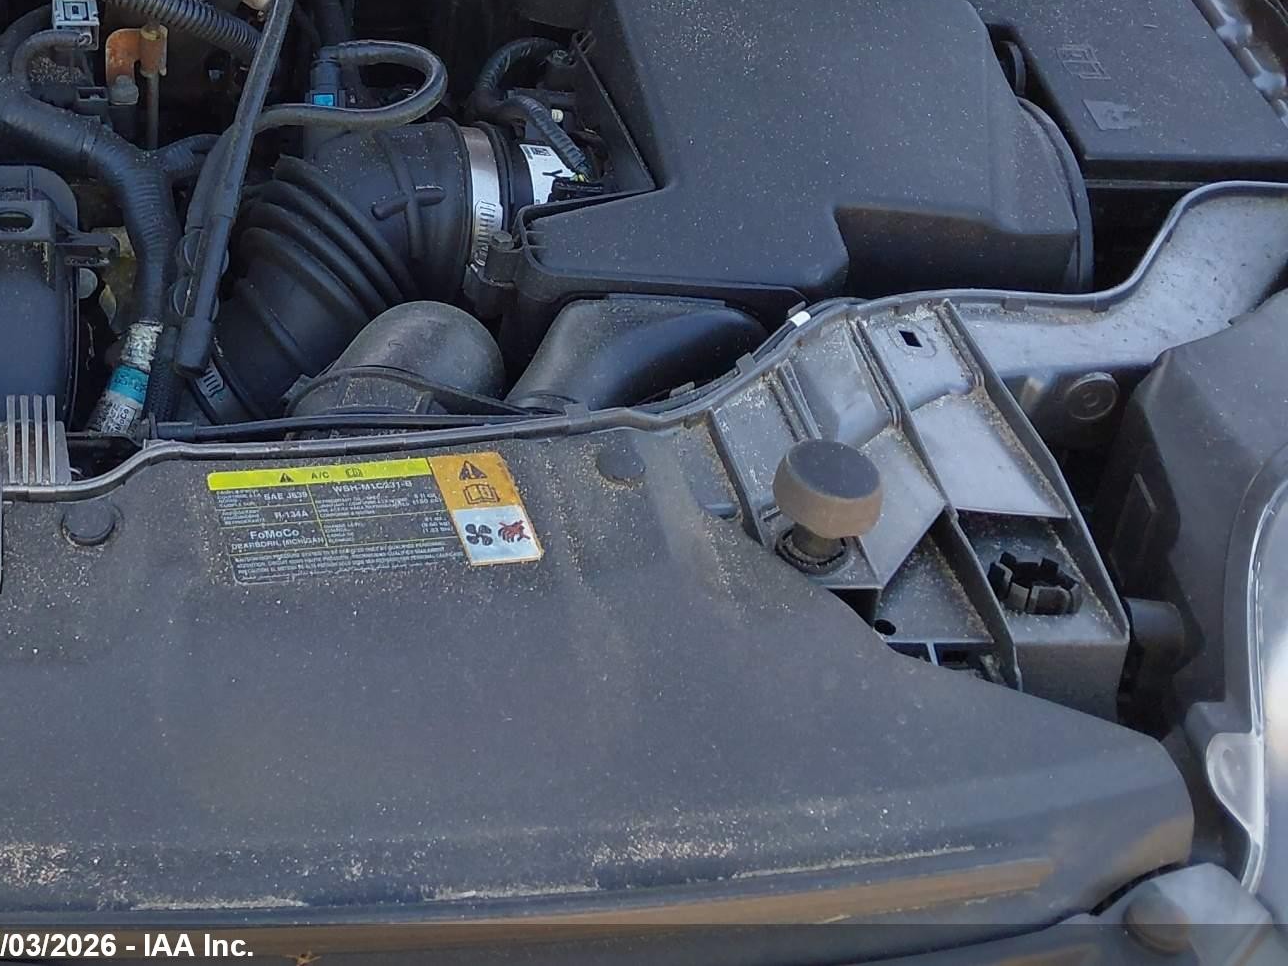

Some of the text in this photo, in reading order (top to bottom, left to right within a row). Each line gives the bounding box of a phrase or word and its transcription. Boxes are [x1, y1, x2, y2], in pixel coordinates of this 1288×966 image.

[311, 471, 330, 480] A/C
[263, 492, 285, 501] SAE
[286, 490, 308, 500] J639
[249, 528, 300, 540] FoMoCo
